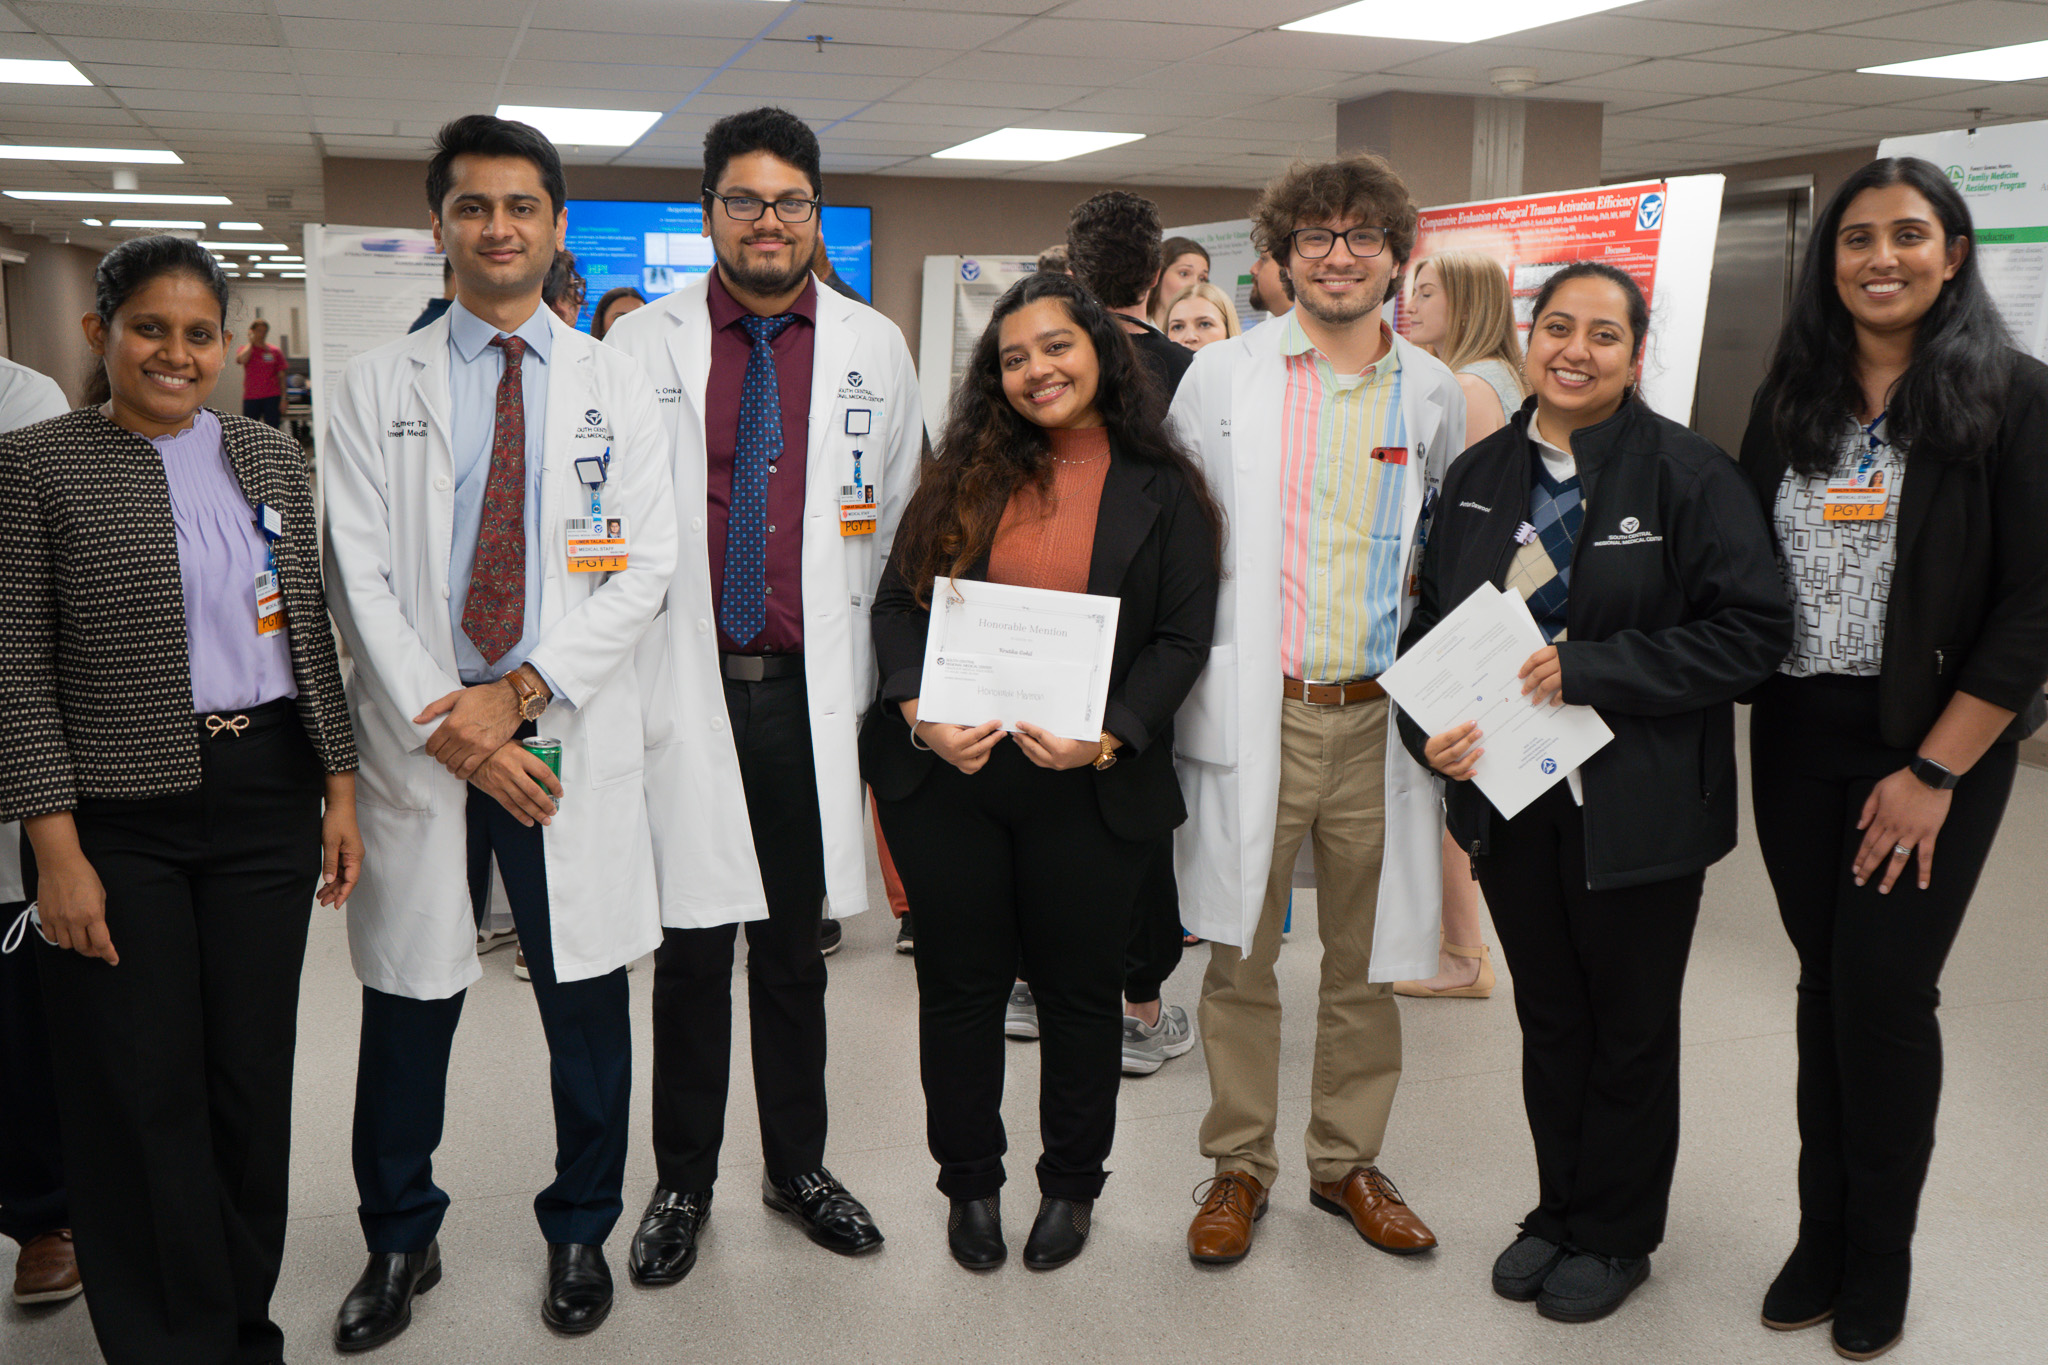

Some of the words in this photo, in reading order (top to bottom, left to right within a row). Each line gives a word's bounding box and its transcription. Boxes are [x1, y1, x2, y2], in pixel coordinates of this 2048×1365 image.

[1967, 173, 1990, 182] Family
[1990, 171, 2019, 180] Medicine
[1965, 183, 1998, 192] Residency
[1999, 181, 2027, 191] Program
[1420, 213, 1457, 231] Comparative
[1458, 210, 1492, 225] Evaluation
[1500, 205, 1529, 223] Surgical
[1529, 203, 1556, 217] Trauma
[1557, 199, 1596, 214] Activation
[1596, 194, 1639, 210] Efficiency
[1976, 231, 2015, 242] roduction
[587, 264, 609, 274] HPI
[1832, 504, 1865, 516] PGY
[1867, 504, 1875, 516] 1
[846, 520, 864, 532] PGY
[867, 519, 872, 530] 1
[1628, 531, 1653, 539] CENTRAL
[1622, 537, 1646, 545] MEDICAL
[577, 557, 605, 568] PGY
[612, 557, 619, 567] 1
[263, 612, 279, 629] PGY
[978, 618, 1027, 632] Honorable
[1029, 624, 1068, 638] Mention
